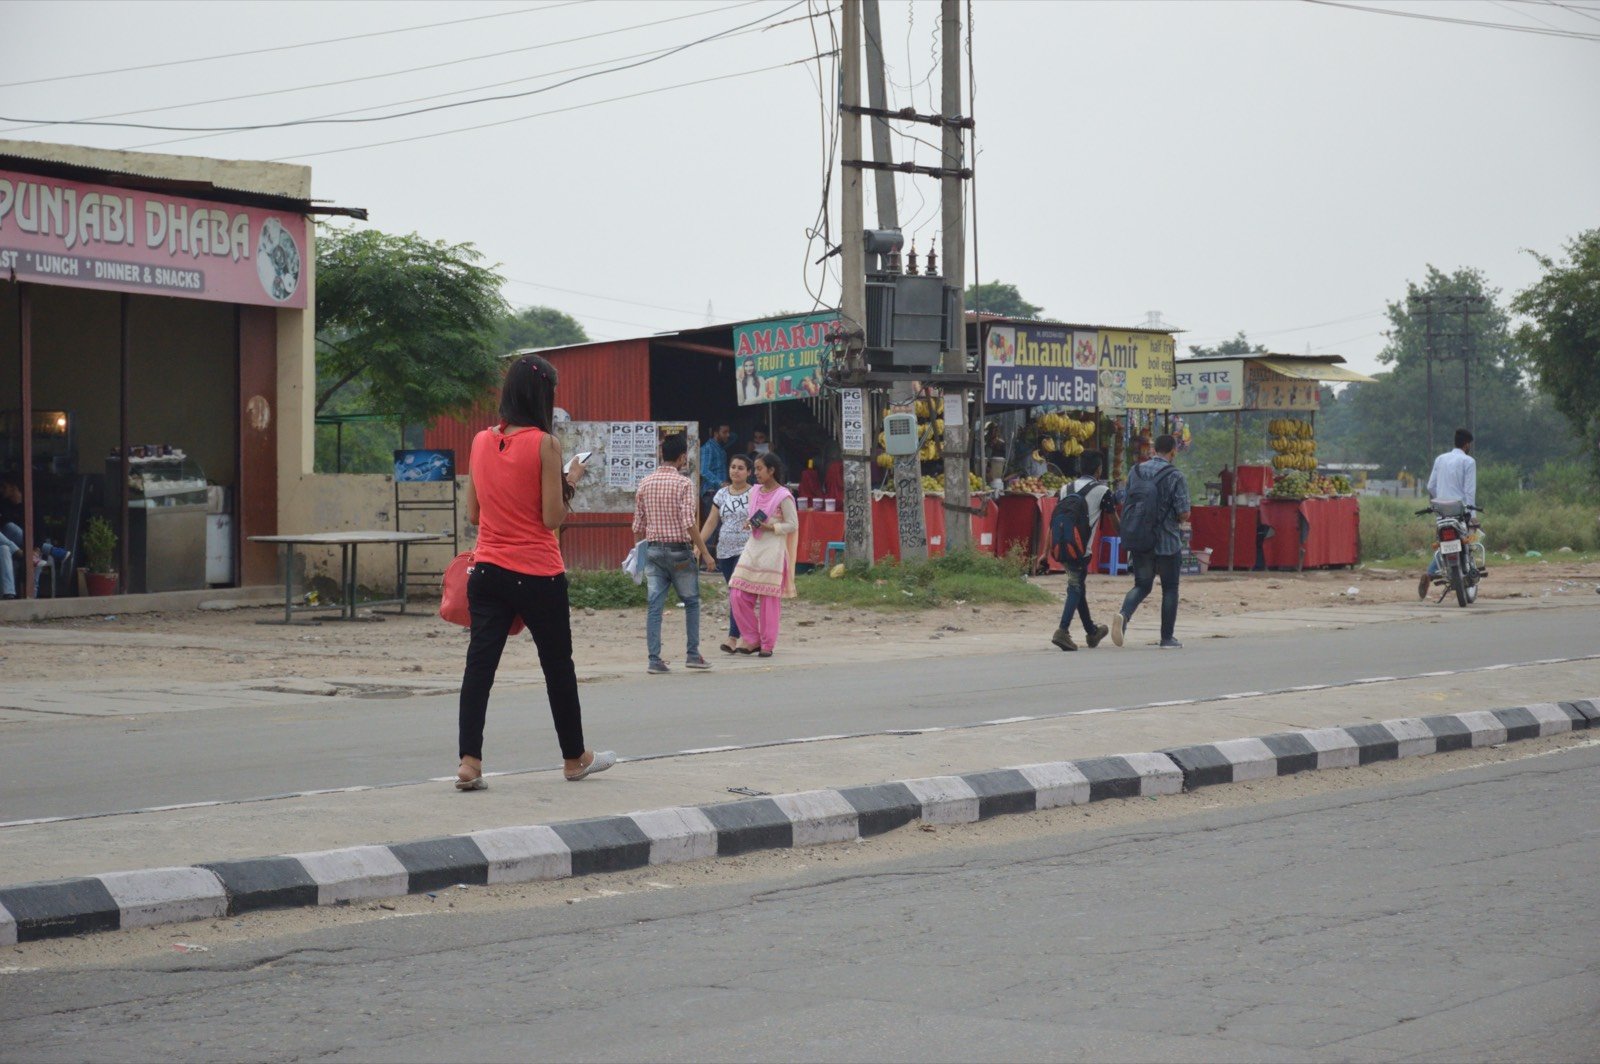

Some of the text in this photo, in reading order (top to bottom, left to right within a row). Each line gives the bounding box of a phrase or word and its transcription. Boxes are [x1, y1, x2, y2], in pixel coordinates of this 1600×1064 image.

[0, 179, 249, 262] PUNJABI DHABA
[0, 250, 200, 288] ST LUNCH DINNER & SNACKS
[1015, 331, 1073, 368] Anand
[1100, 335, 1138, 369] Amit
[757, 353, 785, 371] FRUIT
[788, 352, 796, 367] &
[1199, 371, 1230, 384] बार
[843, 391, 860, 399] PG
[992, 373, 1097, 402] Fruit & Juice Bar
[612, 425, 631, 433] PG
[635, 425, 654, 433] PG
[845, 421, 861, 429] PG
[611, 458, 630, 466] PG
[635, 460, 654, 468] PG
[898, 477, 918, 494] PG
